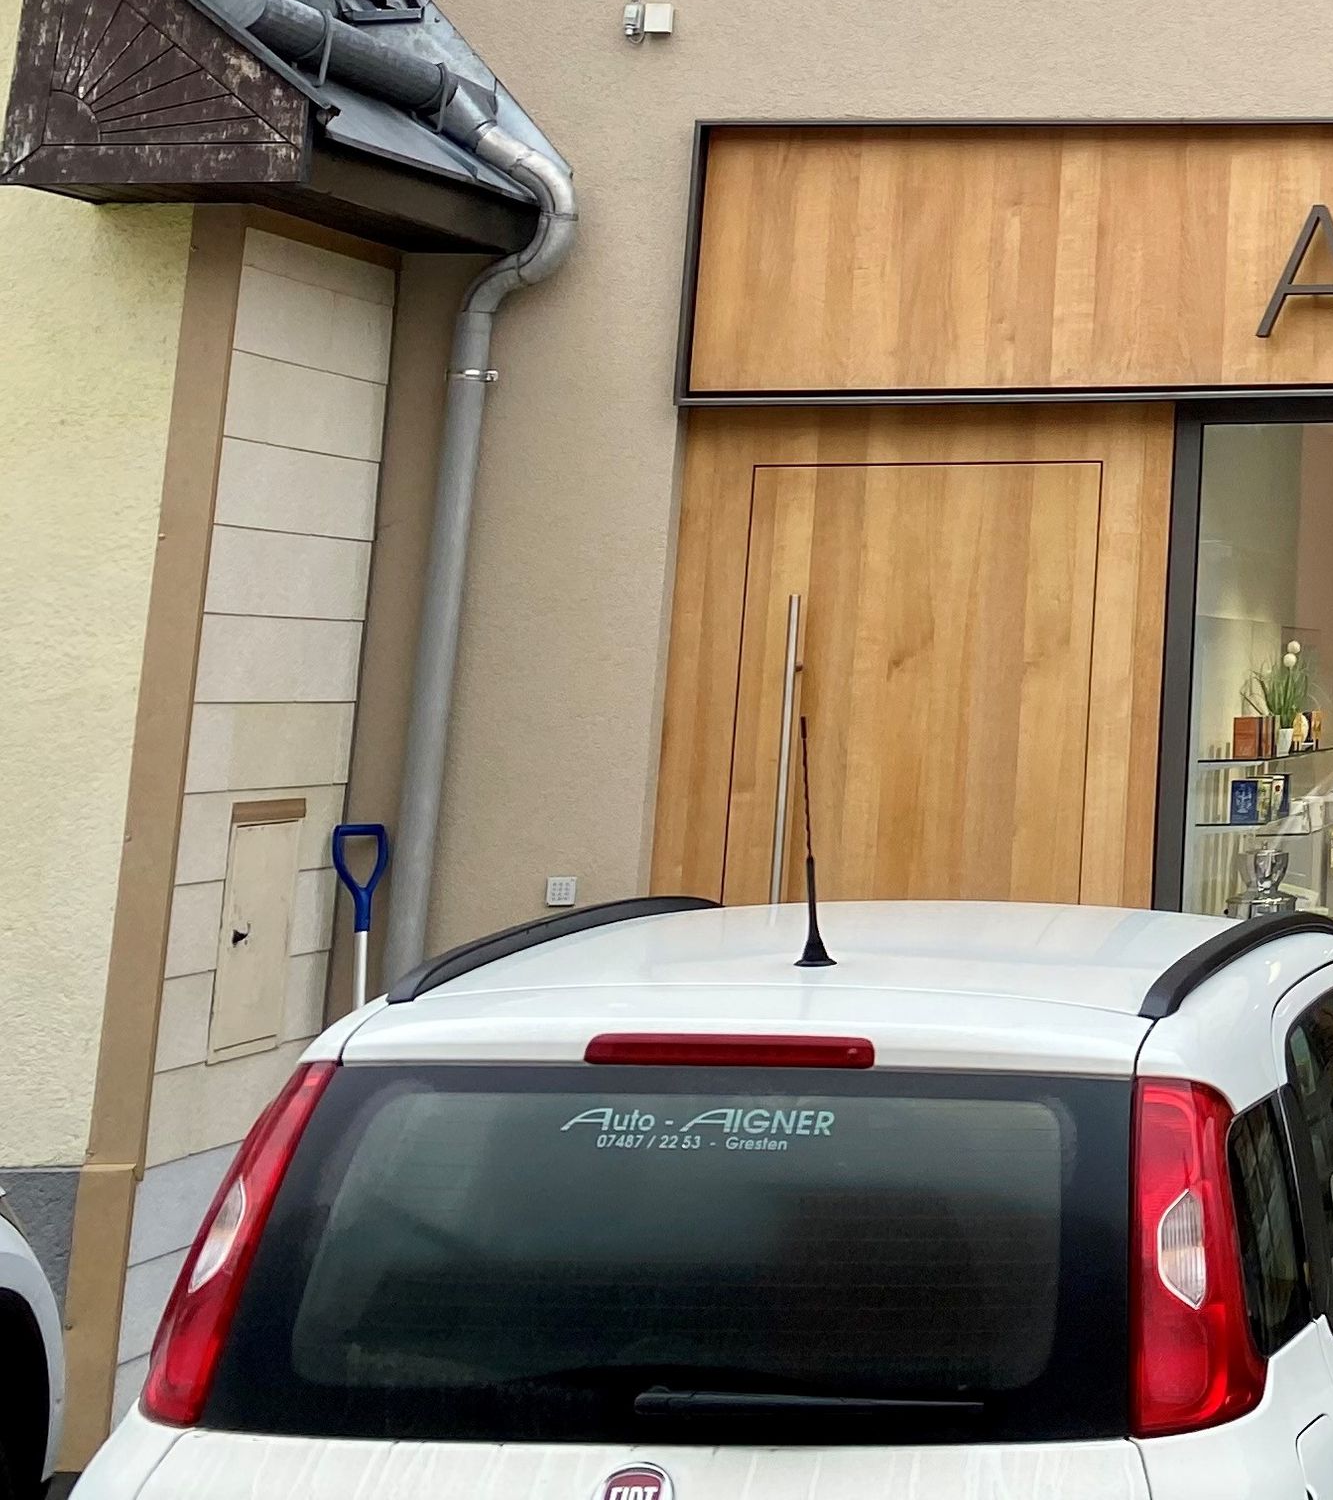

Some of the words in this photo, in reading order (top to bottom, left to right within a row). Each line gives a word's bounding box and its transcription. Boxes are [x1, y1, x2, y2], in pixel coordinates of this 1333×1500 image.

[560, 1107, 655, 1131] Auto
[679, 1108, 835, 1137] AIGNER
[597, 1134, 642, 1149] 07487
[659, 1135, 677, 1150] 22
[682, 1135, 701, 1150] 53
[725, 1136, 788, 1151] Gresten
